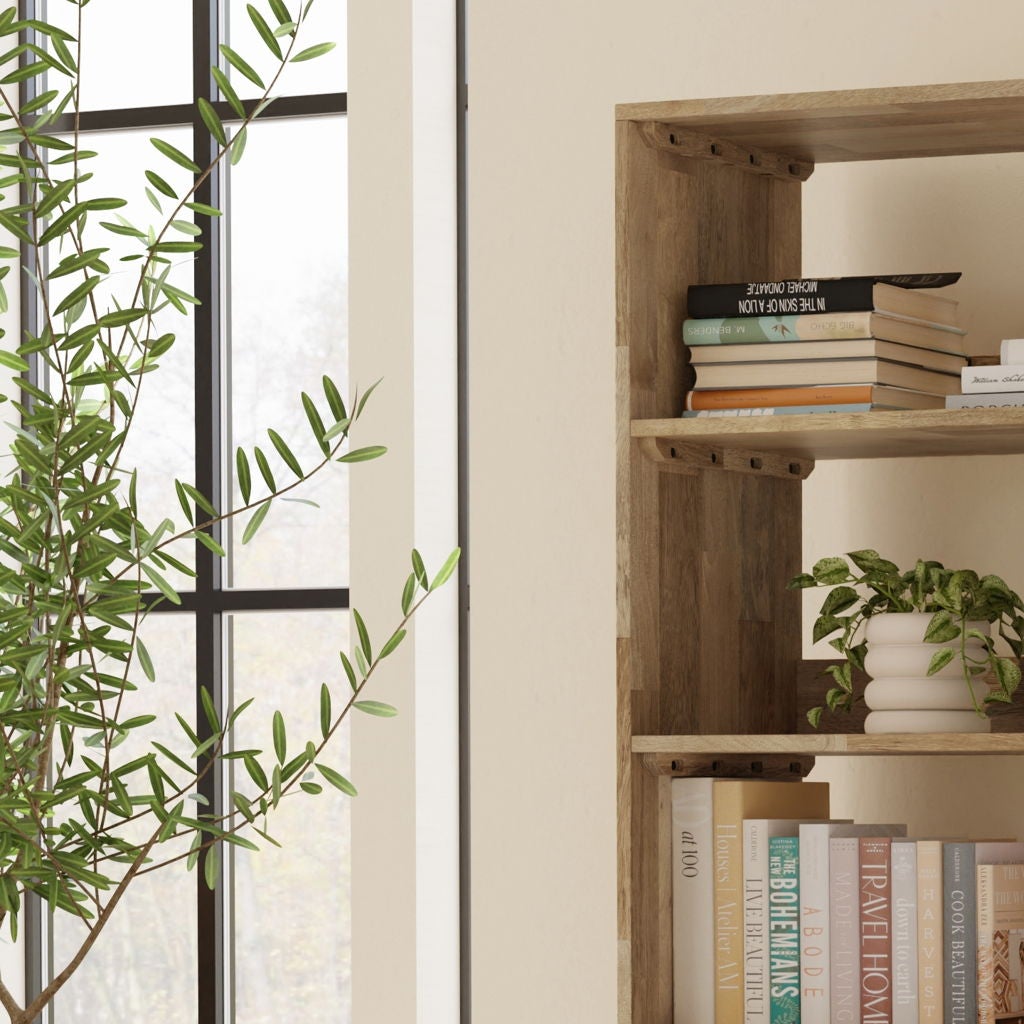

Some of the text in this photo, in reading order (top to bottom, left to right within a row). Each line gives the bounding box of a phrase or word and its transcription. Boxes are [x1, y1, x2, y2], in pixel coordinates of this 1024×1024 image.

[738, 297, 826, 313] IN THE SKIN OF A LION
[747, 281, 818, 295] MICHAEL ONDAATJE
[687, 325, 746, 336] M. BENDERS
[681, 830, 699, 878] at 100
[770, 856, 782, 875] NEW
[783, 858, 797, 875] THE
[716, 823, 738, 990] Houses Atelier AM
[835, 871, 854, 929] MADE
[861, 859, 889, 947] TRAVEL
[951, 889, 966, 934] COOK
[745, 878, 764, 1021] LIVE BEAUTIFUL
[769, 878, 799, 998] BOHEMIANS
[803, 906, 825, 998] ABODE
[896, 897, 915, 1004] down to earth
[835, 949, 854, 1022] LIVING
